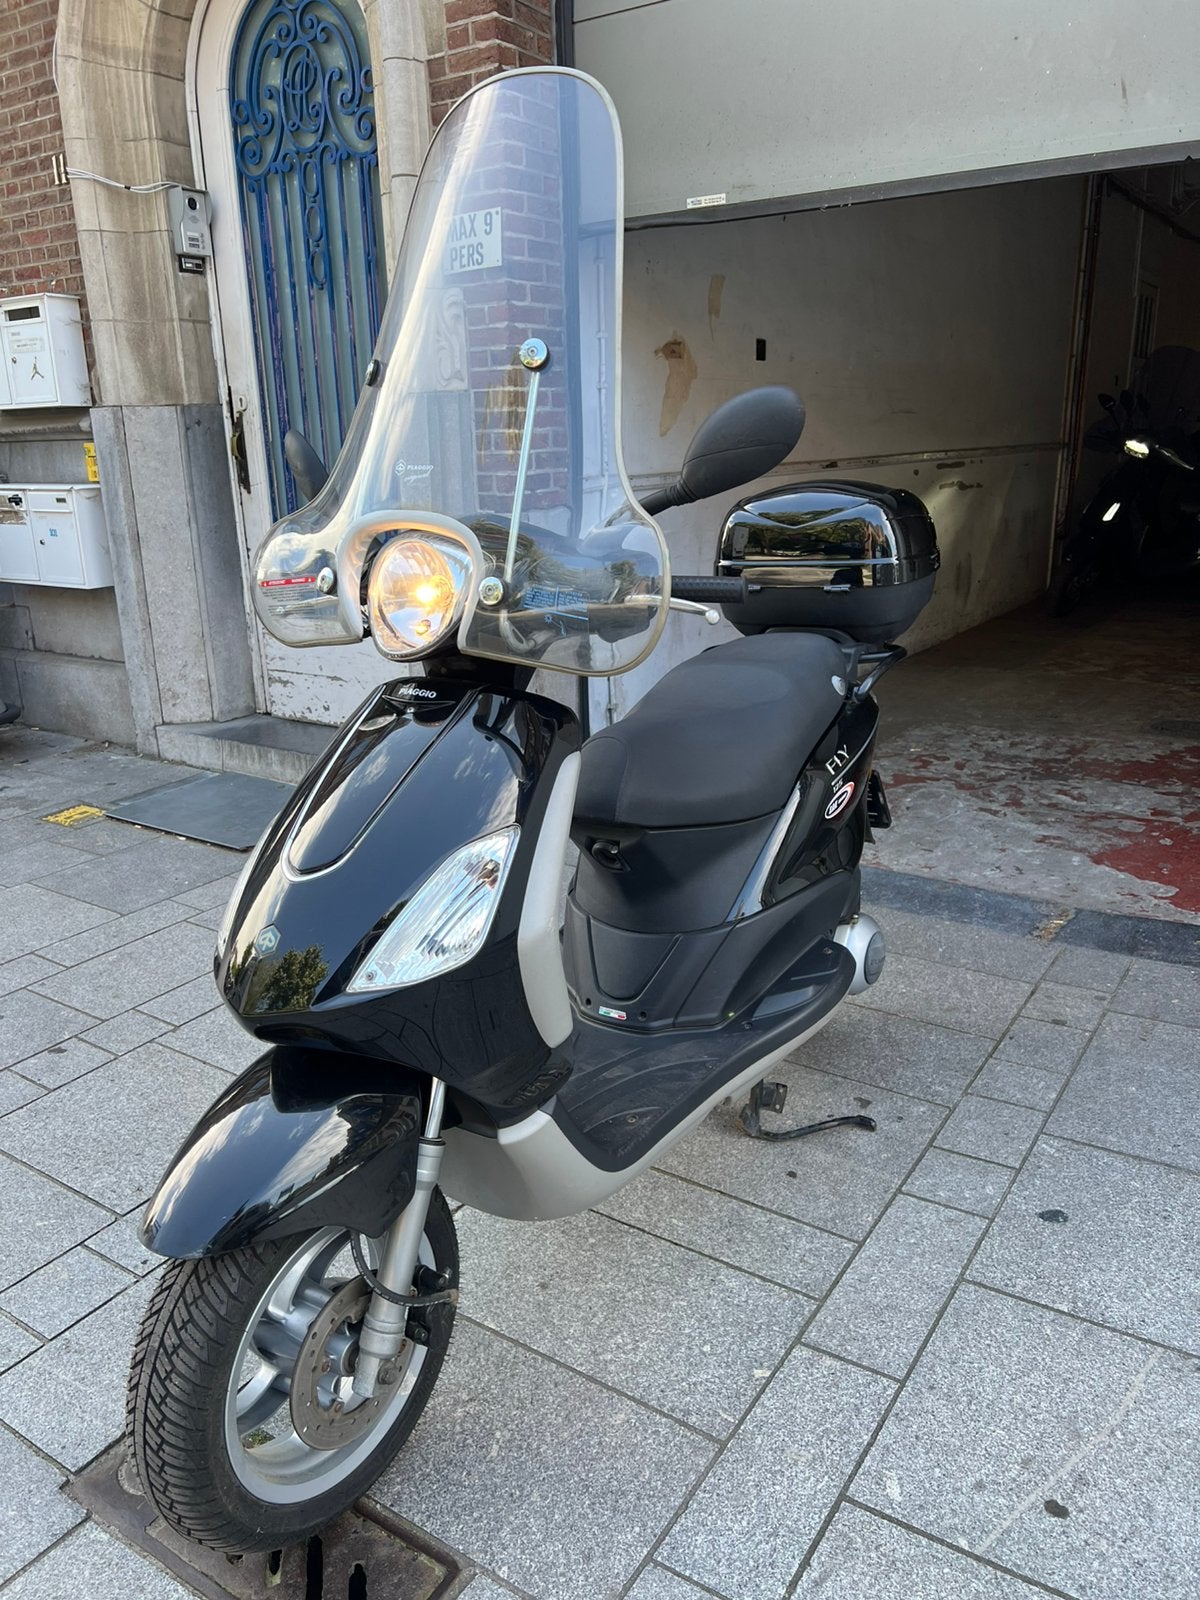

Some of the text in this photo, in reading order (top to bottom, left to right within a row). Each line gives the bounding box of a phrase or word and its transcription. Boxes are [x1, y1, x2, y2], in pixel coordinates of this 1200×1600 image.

[483, 210, 493, 236] 9
[449, 241, 484, 271] PERS
[398, 687, 437, 699] PIAGGIO
[825, 744, 849, 775] FLY
